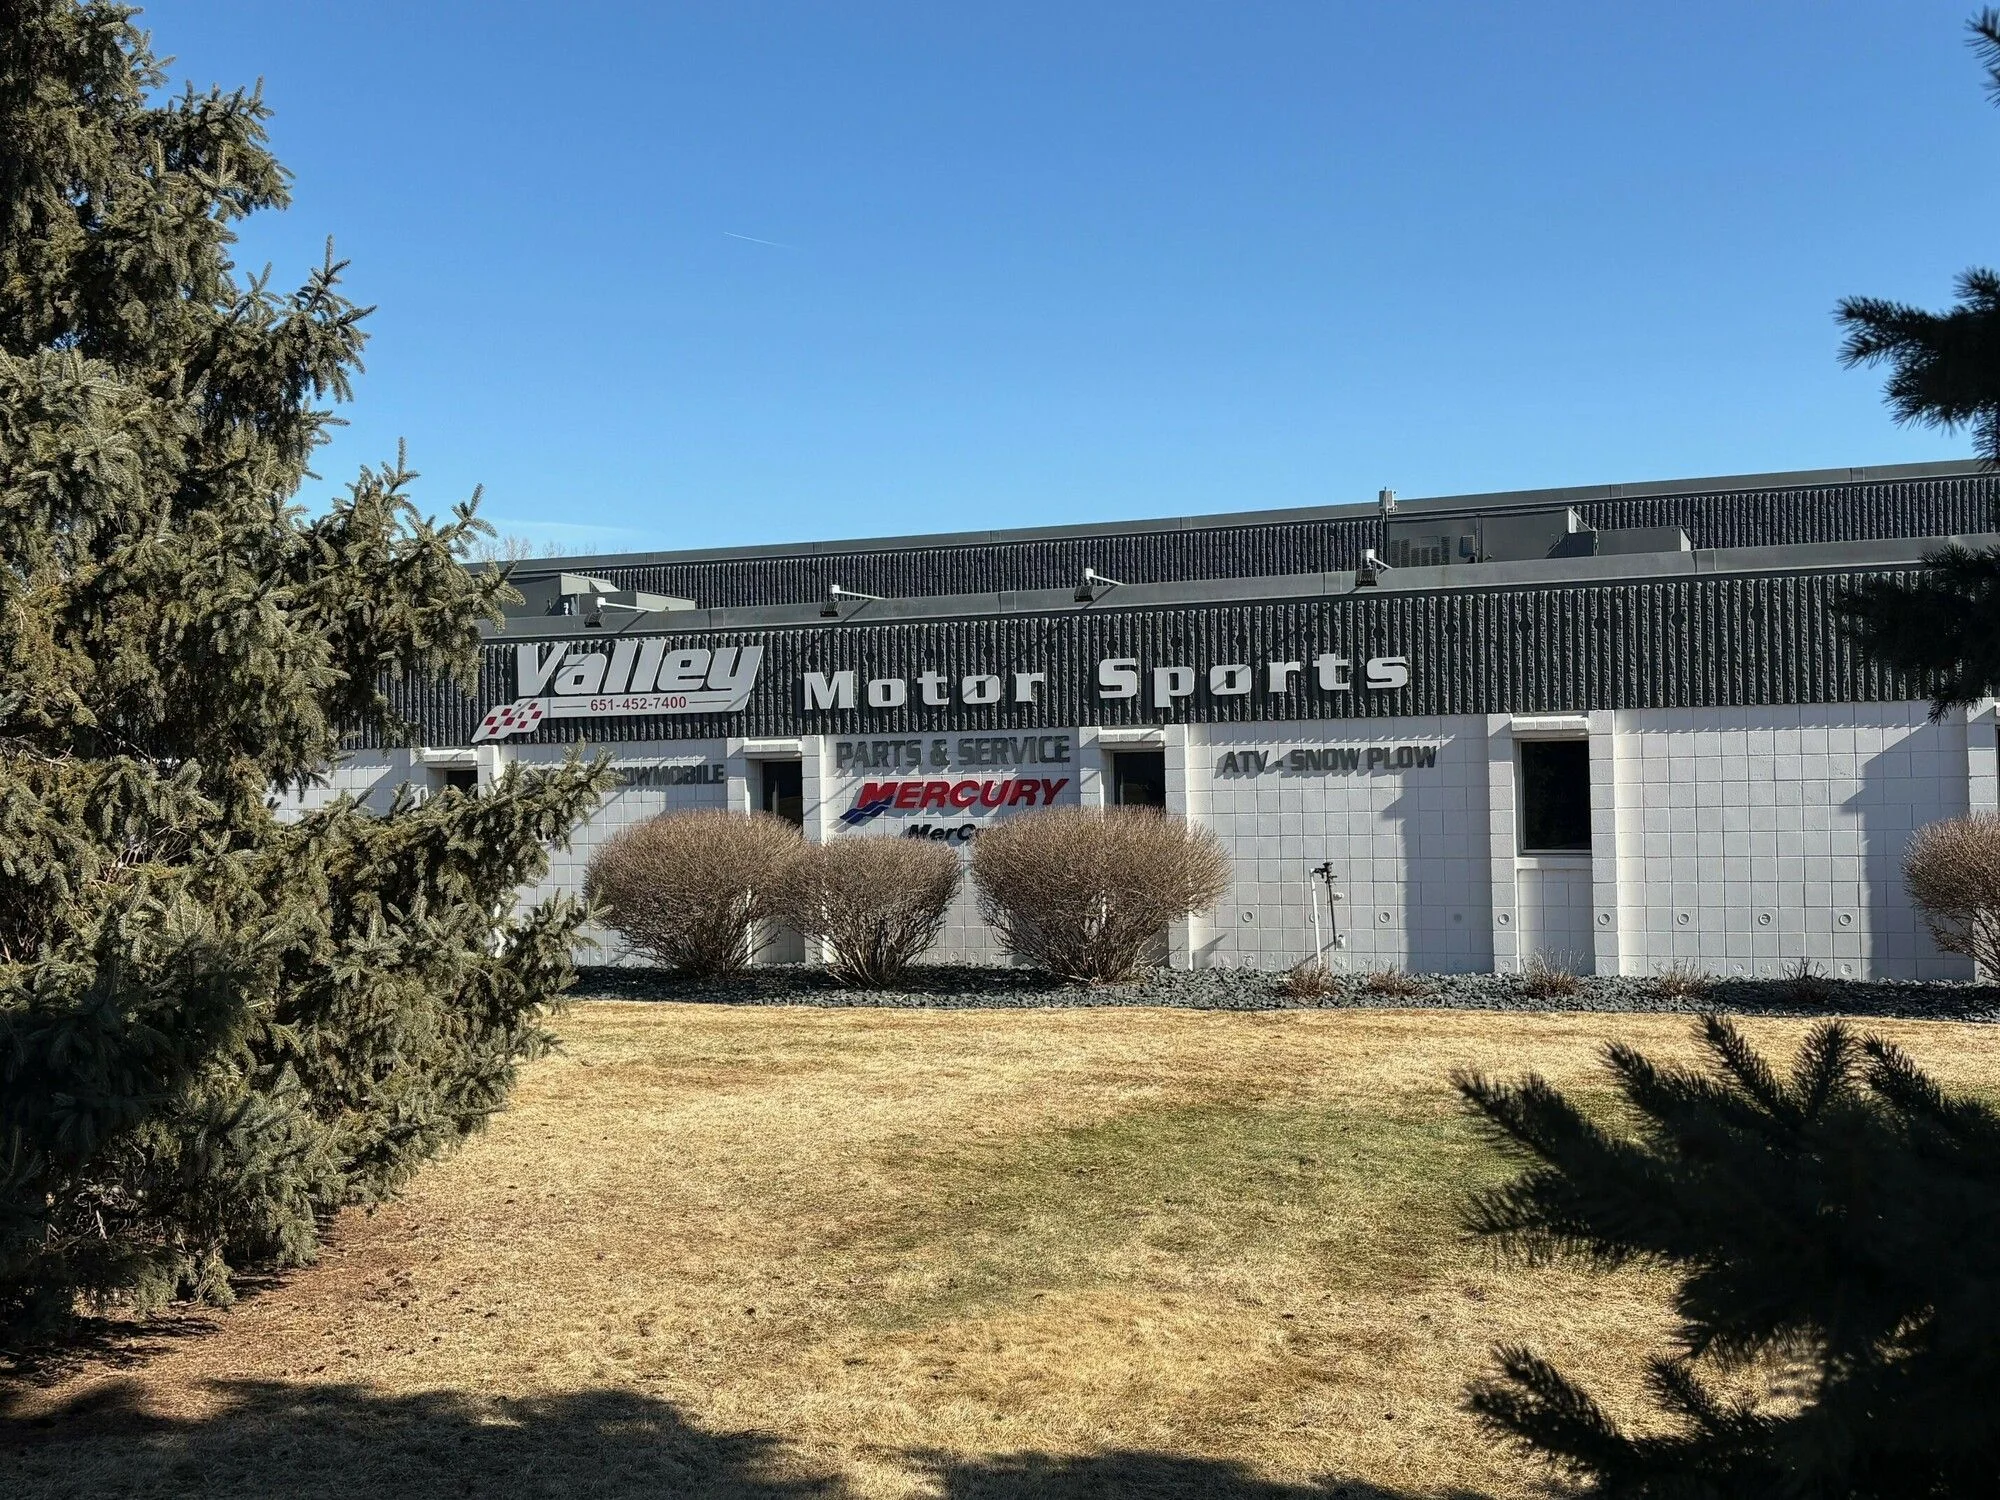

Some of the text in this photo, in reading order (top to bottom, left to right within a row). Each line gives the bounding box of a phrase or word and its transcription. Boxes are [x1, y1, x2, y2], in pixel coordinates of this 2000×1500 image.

[517, 637, 764, 698] Valley
[803, 653, 1409, 711] Motor Sports
[590, 696, 687, 711] 651-452-7400
[836, 735, 1071, 768] PARTS & SERVICE
[1223, 750, 1269, 773] ATV
[1290, 747, 1361, 772] SNOW
[1367, 746, 1437, 769] PLOW
[605, 764, 725, 786] OWMOBILE
[856, 778, 1070, 809] MERCURY
